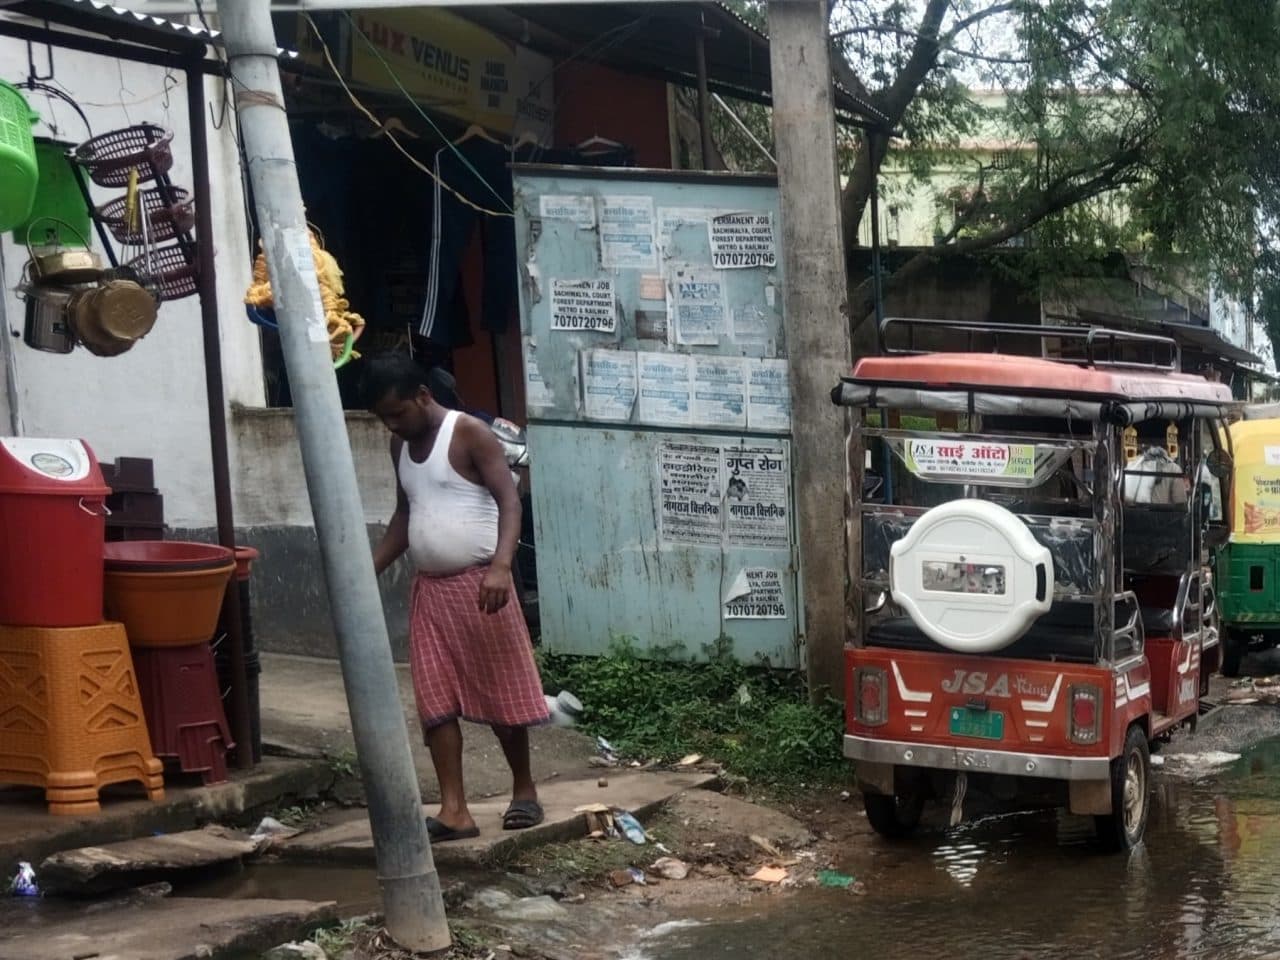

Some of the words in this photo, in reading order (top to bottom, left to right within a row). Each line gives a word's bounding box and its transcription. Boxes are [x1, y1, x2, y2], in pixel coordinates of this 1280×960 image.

[358, 15, 408, 55] LUX
[411, 36, 471, 82] VENUS
[756, 216, 770, 225] JOB
[713, 253, 775, 265] 7070720796
[596, 281, 610, 290] JOB
[554, 315, 614, 329] 7070720796
[725, 457, 755, 476] गुप्त
[757, 455, 782, 471] रोग
[726, 603, 785, 616] 7070720796
[941, 669, 1012, 698] JSA
